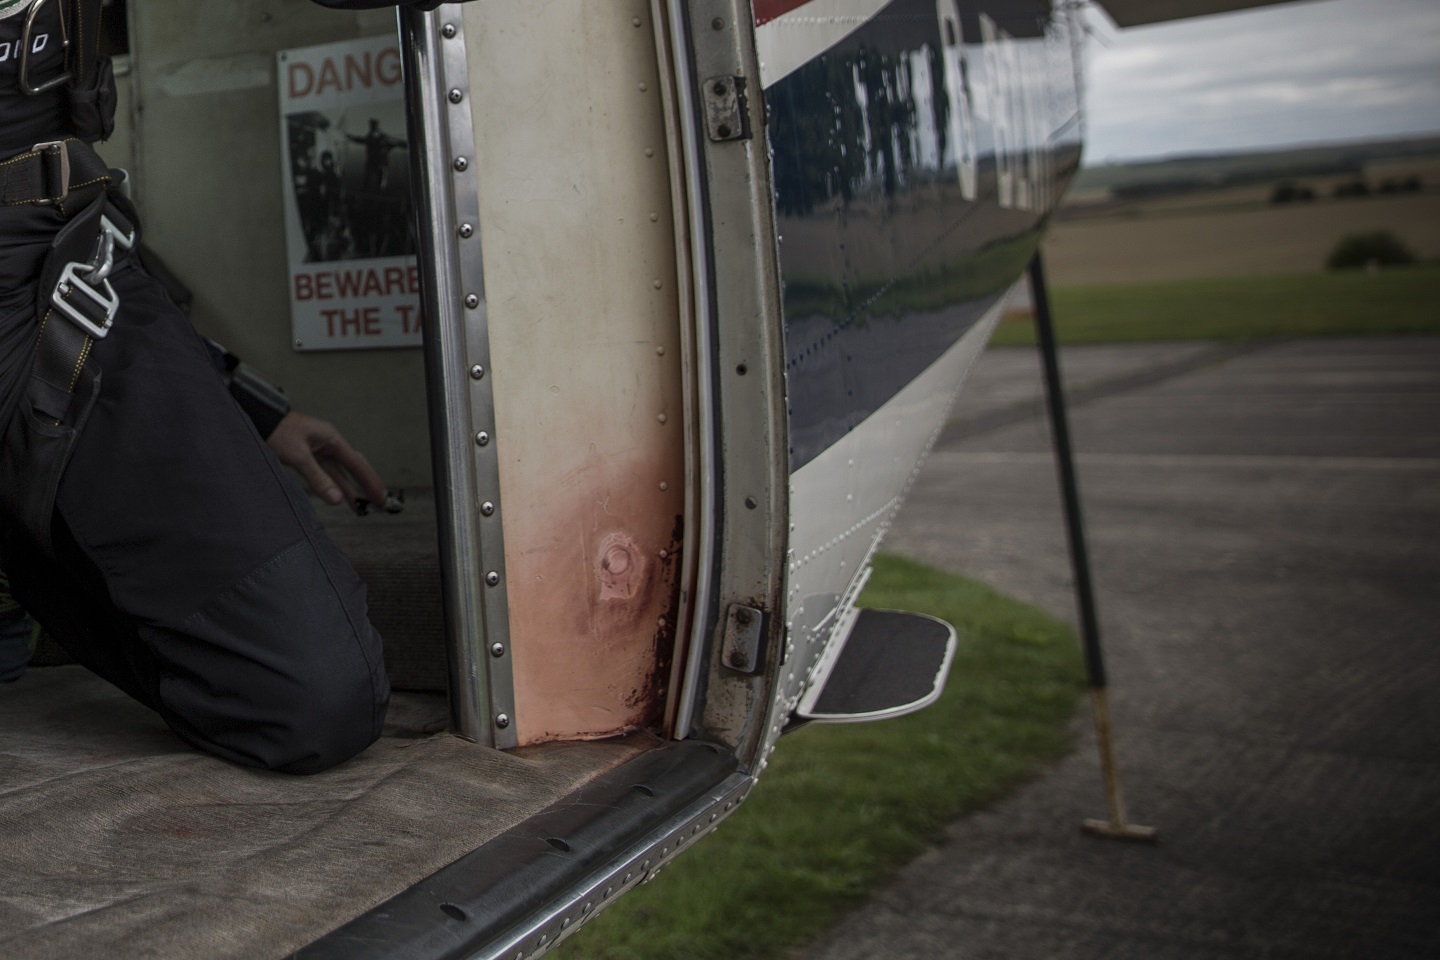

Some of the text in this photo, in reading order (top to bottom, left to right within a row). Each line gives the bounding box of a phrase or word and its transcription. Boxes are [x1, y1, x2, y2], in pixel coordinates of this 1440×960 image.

[287, 47, 401, 99] DANG
[293, 266, 420, 301] BEWARE
[320, 306, 382, 337] THE
